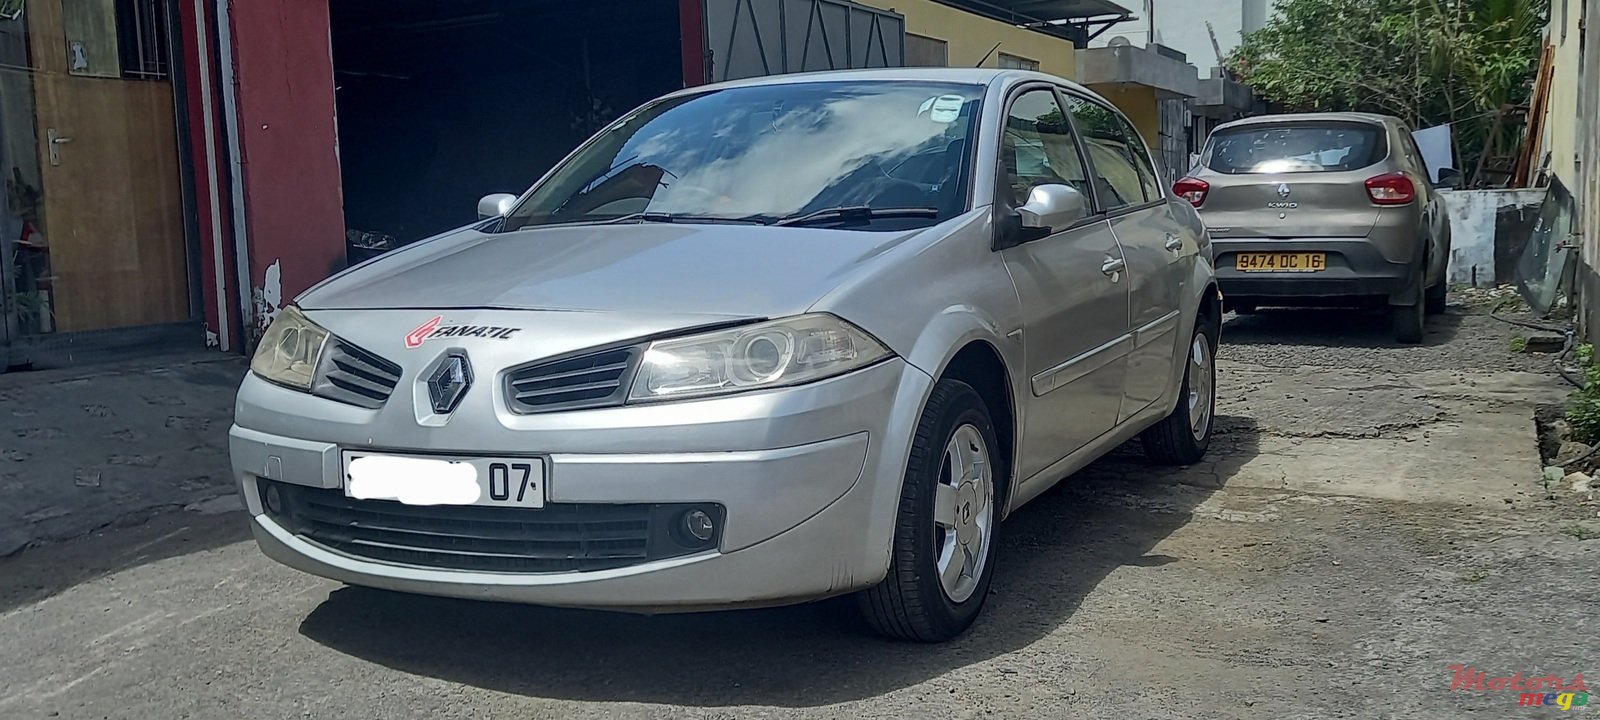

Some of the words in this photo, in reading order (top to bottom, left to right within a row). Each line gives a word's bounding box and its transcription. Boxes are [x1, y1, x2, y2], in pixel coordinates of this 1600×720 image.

[1240, 254, 1275, 268] 9474
[1280, 254, 1298, 268] DC
[1305, 254, 1321, 268] 16
[427, 325, 522, 340] FANATIC
[489, 462, 531, 502] 07
